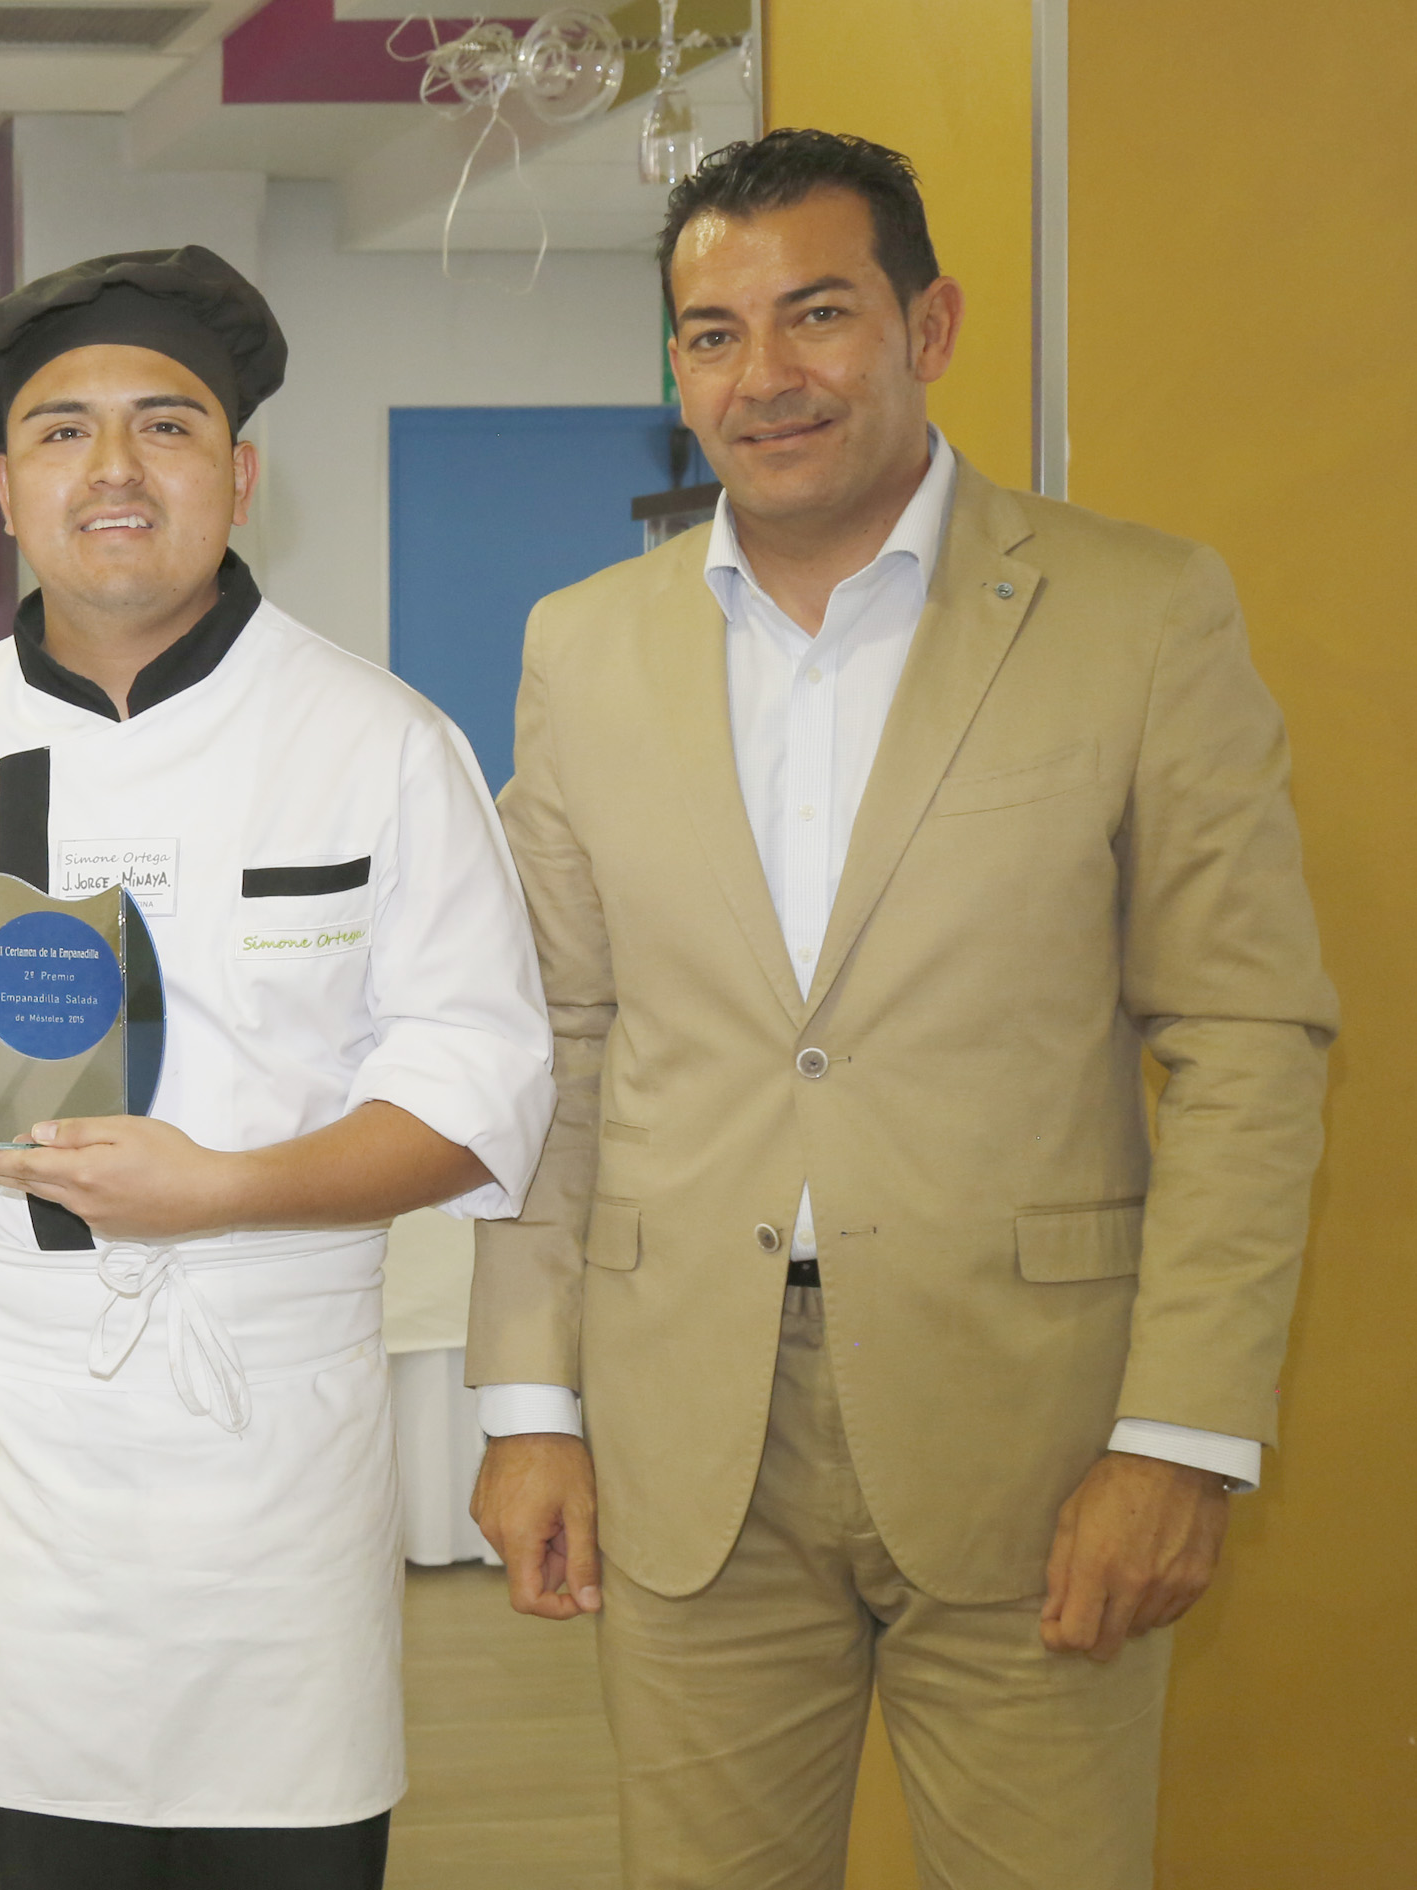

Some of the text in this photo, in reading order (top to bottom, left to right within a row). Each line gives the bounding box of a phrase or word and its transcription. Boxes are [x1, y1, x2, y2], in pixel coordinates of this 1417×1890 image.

[64, 852, 171, 865] Simone Ortega
[74, 873, 110, 889] JORGE
[242, 930, 366, 951] Simone Ortega
[5, 946, 37, 957] Certamen
[39, 947, 48, 958] de
[50, 947, 57, 958] la
[59, 947, 99, 960] Empanadilla
[41, 971, 75, 981] Premio
[0, 992, 98, 1005] Empanadilla Salada
[15, 1014, 85, 1024] de Móstoles 2015
